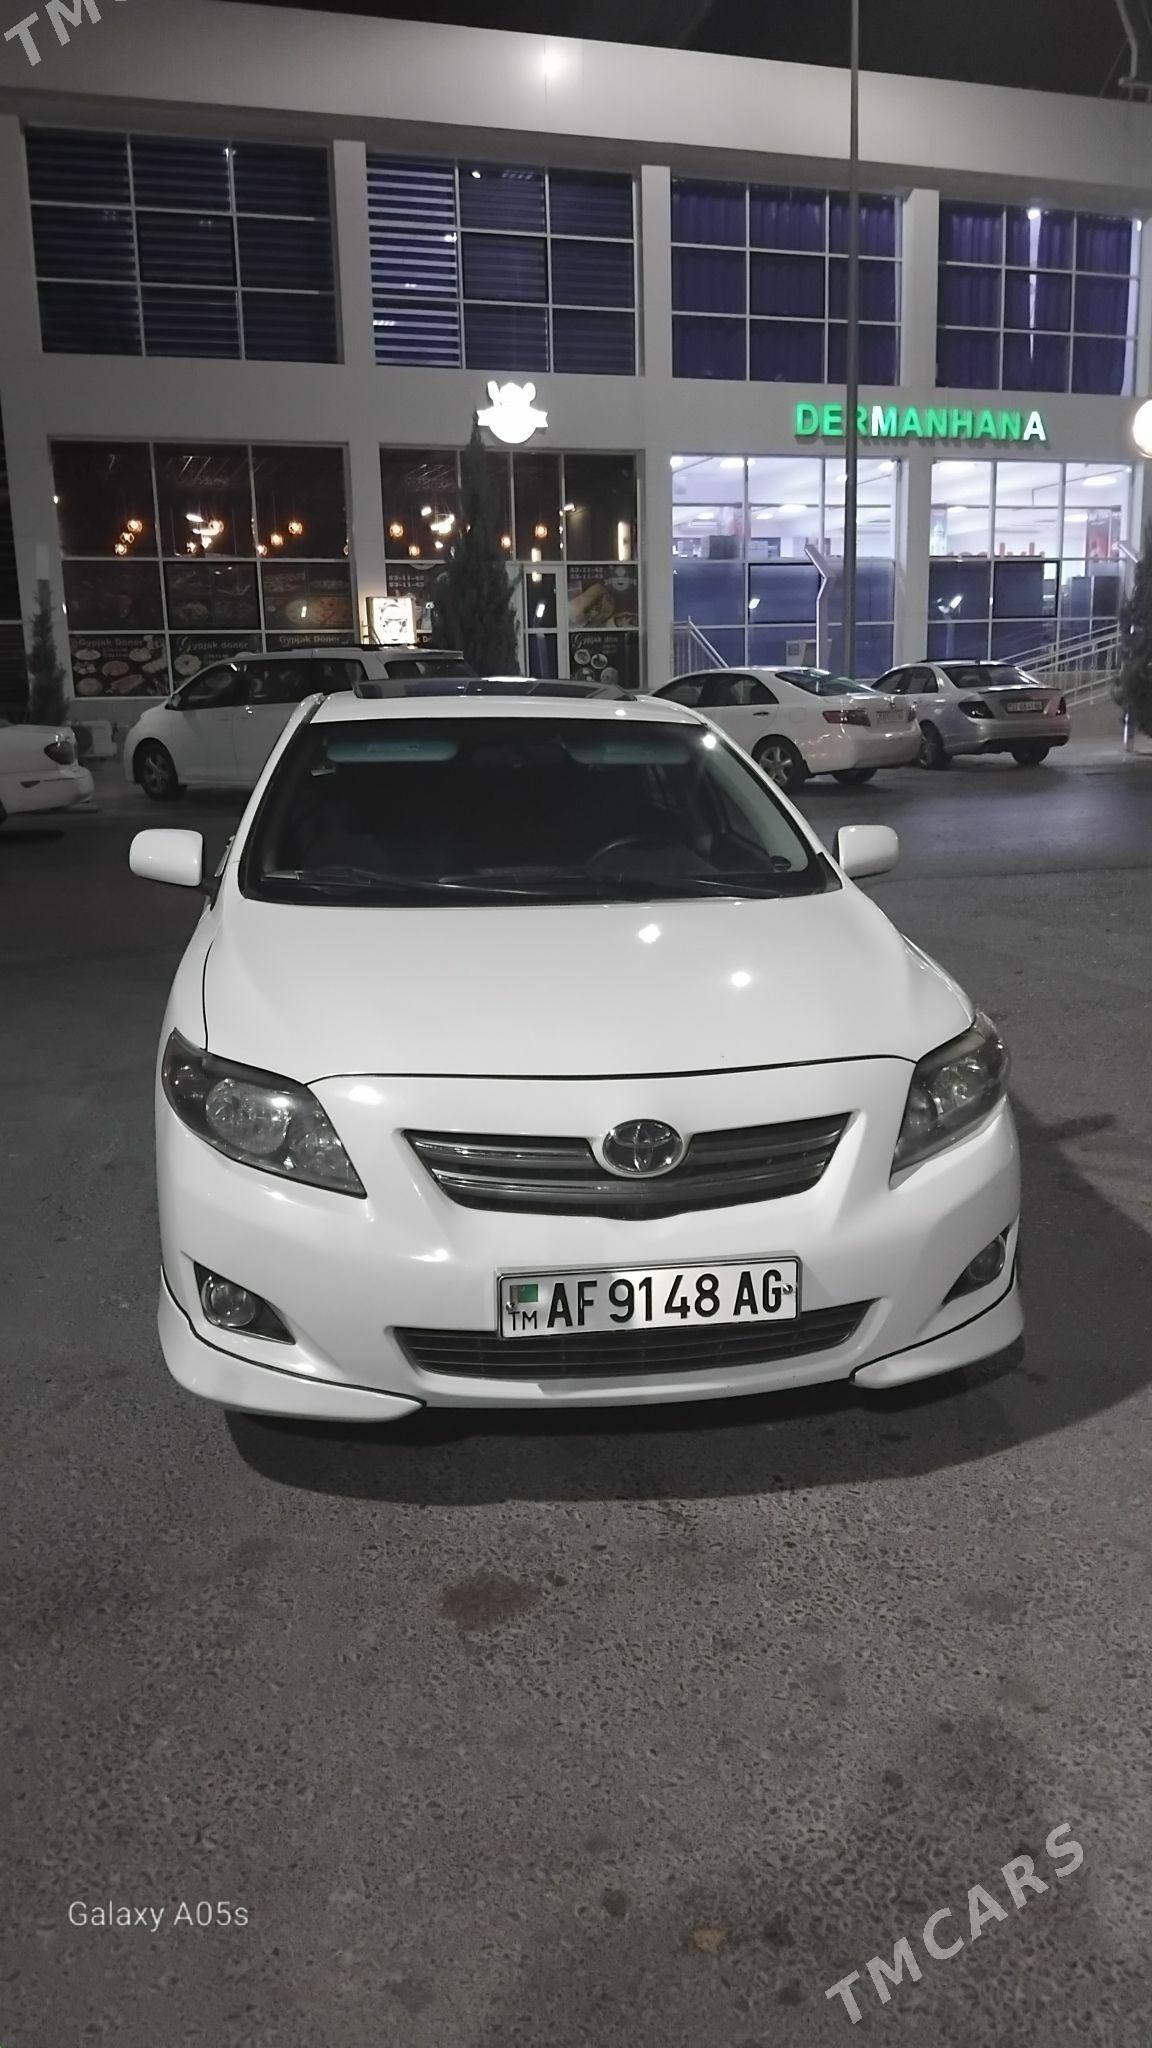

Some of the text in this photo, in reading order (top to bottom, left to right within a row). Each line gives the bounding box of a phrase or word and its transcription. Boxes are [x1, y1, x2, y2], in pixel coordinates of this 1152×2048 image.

[795, 403, 1047, 441] DERMANHANA
[509, 1269, 782, 1331] TM AF 9148 AG
